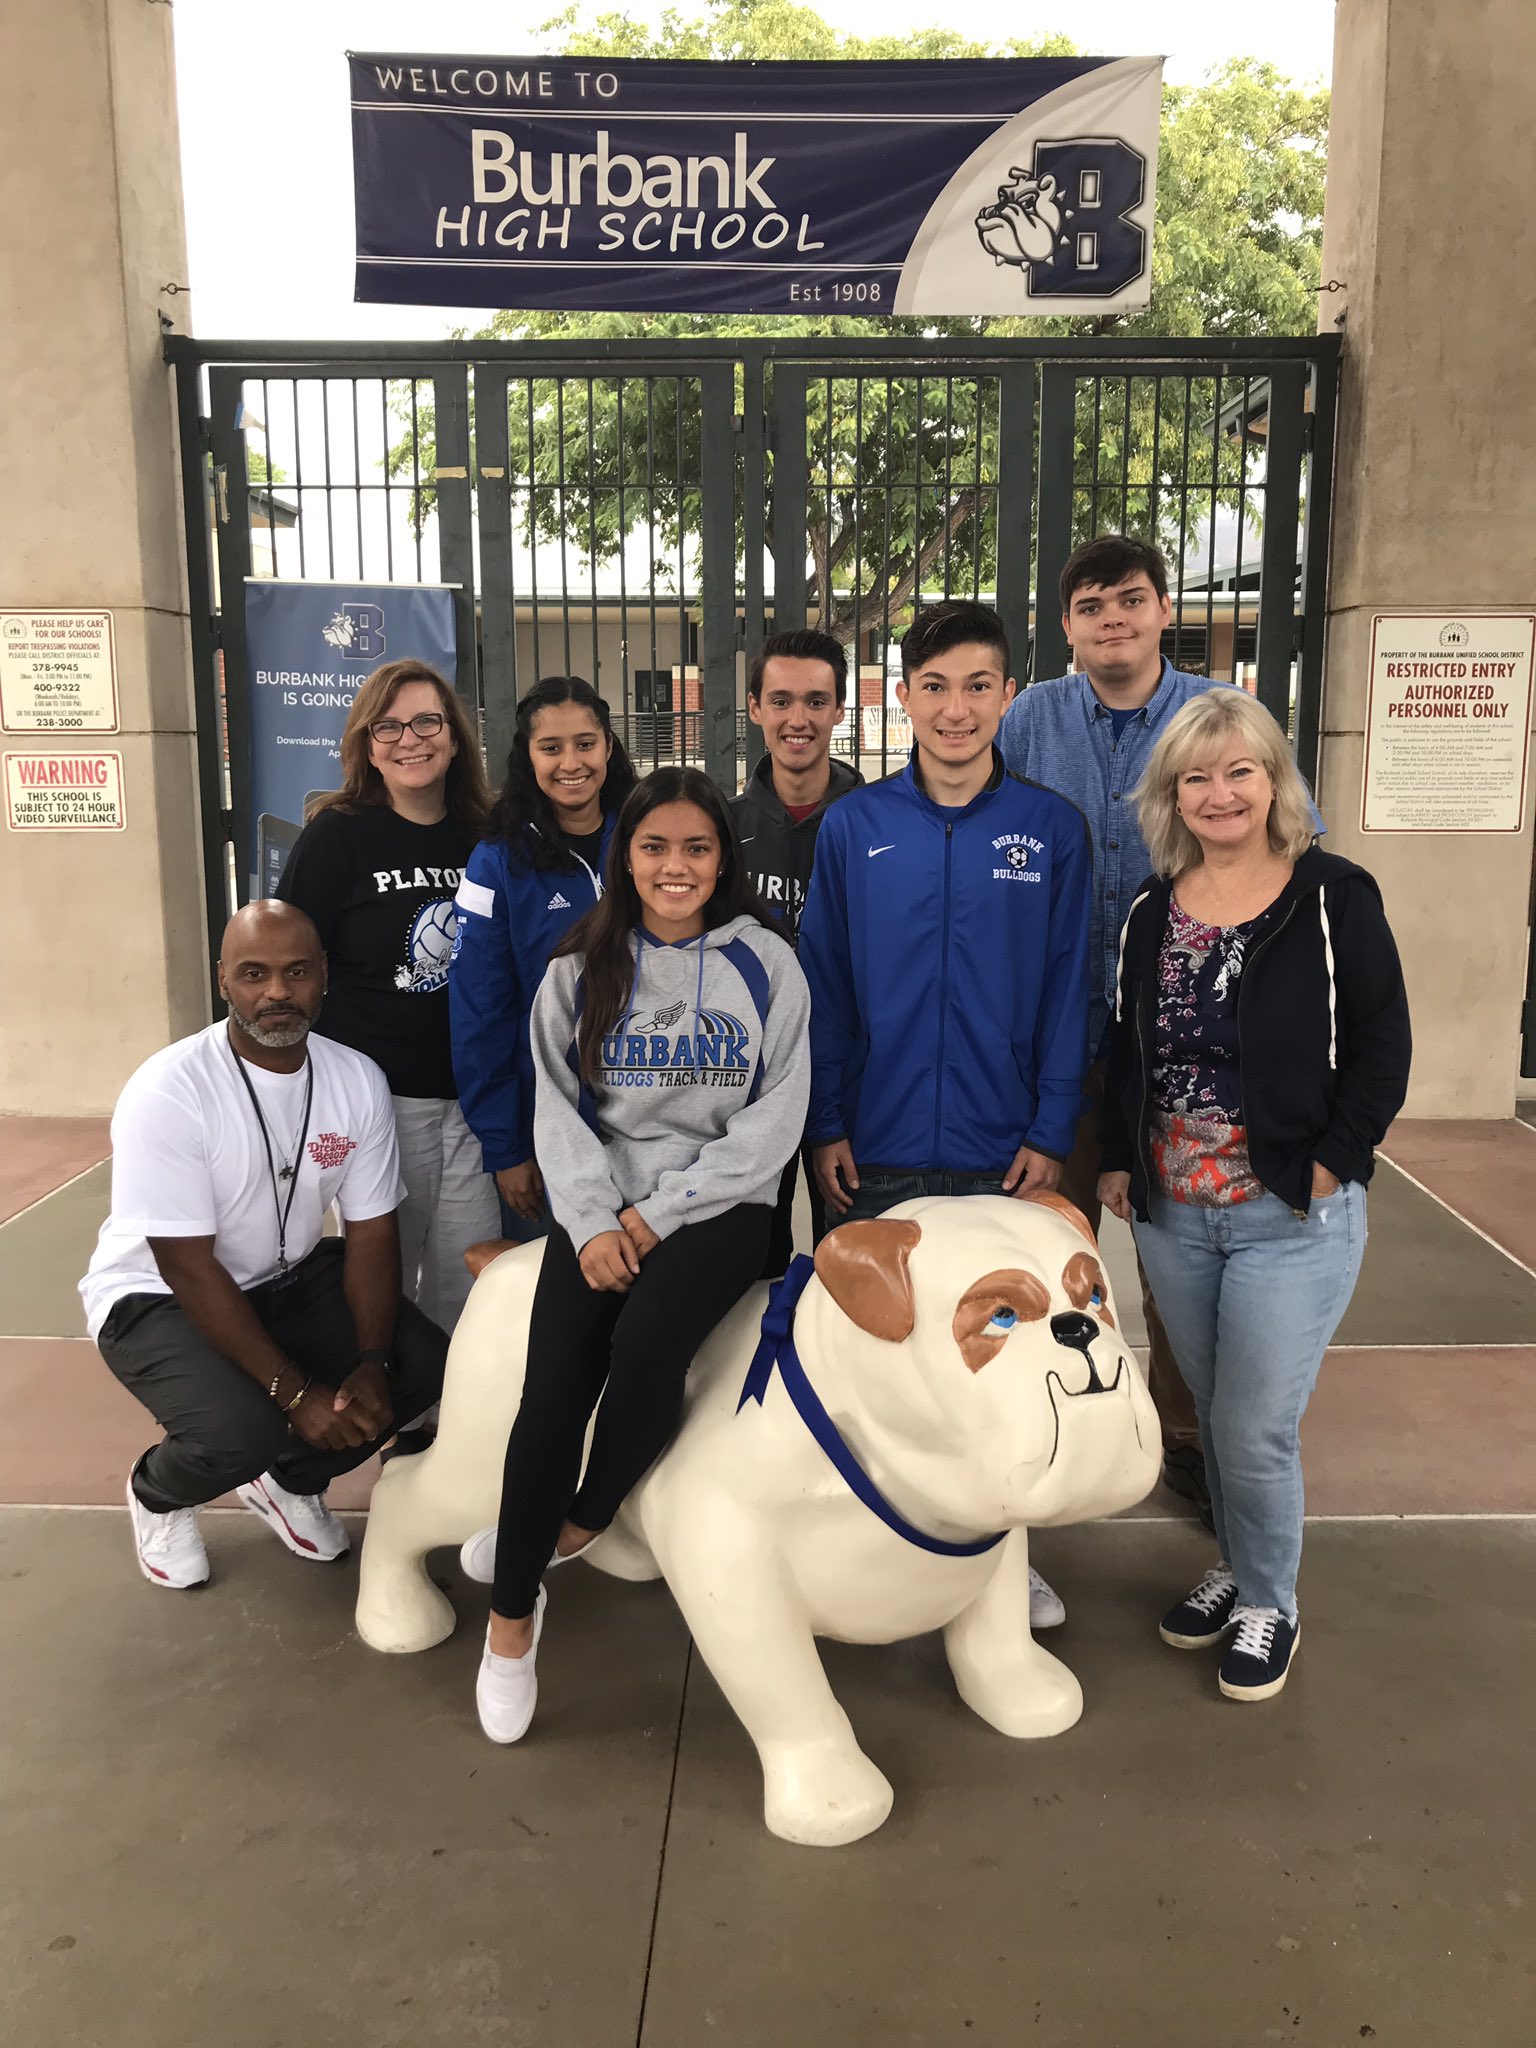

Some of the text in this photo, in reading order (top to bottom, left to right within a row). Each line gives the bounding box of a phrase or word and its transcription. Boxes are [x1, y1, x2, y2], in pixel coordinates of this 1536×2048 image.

[375, 65, 620, 98] WELCOME TO
[471, 129, 777, 210] Burbank
[436, 206, 826, 253] HIGH SCHOOL
[790, 283, 882, 303] Est 1908
[1387, 663, 1516, 678] RESTRICTED ENTRY
[256, 671, 368, 688] BURBANK HIG
[284, 692, 354, 707] IS GOING
[1405, 685, 1494, 700] AUTHORIZED
[1388, 703, 1509, 718] PERSONNEL ONLY
[276, 736, 336, 746] Download the
[328, 749, 340, 759] Ap
[18, 760, 108, 784] WARNING
[27, 792, 102, 801] THIS SCHOOL IS
[14, 803, 116, 812] SUBJECT TO 24 HOUR
[16, 814, 116, 823] VIDEO SURVEILLANCE
[992, 834, 1045, 854] BURBANK
[992, 869, 1042, 882] BULLDOGS
[548, 902, 571, 910] adidas
[602, 1034, 750, 1068] URBANK
[602, 1071, 746, 1087] LLDOGS TRACK & FIELD
